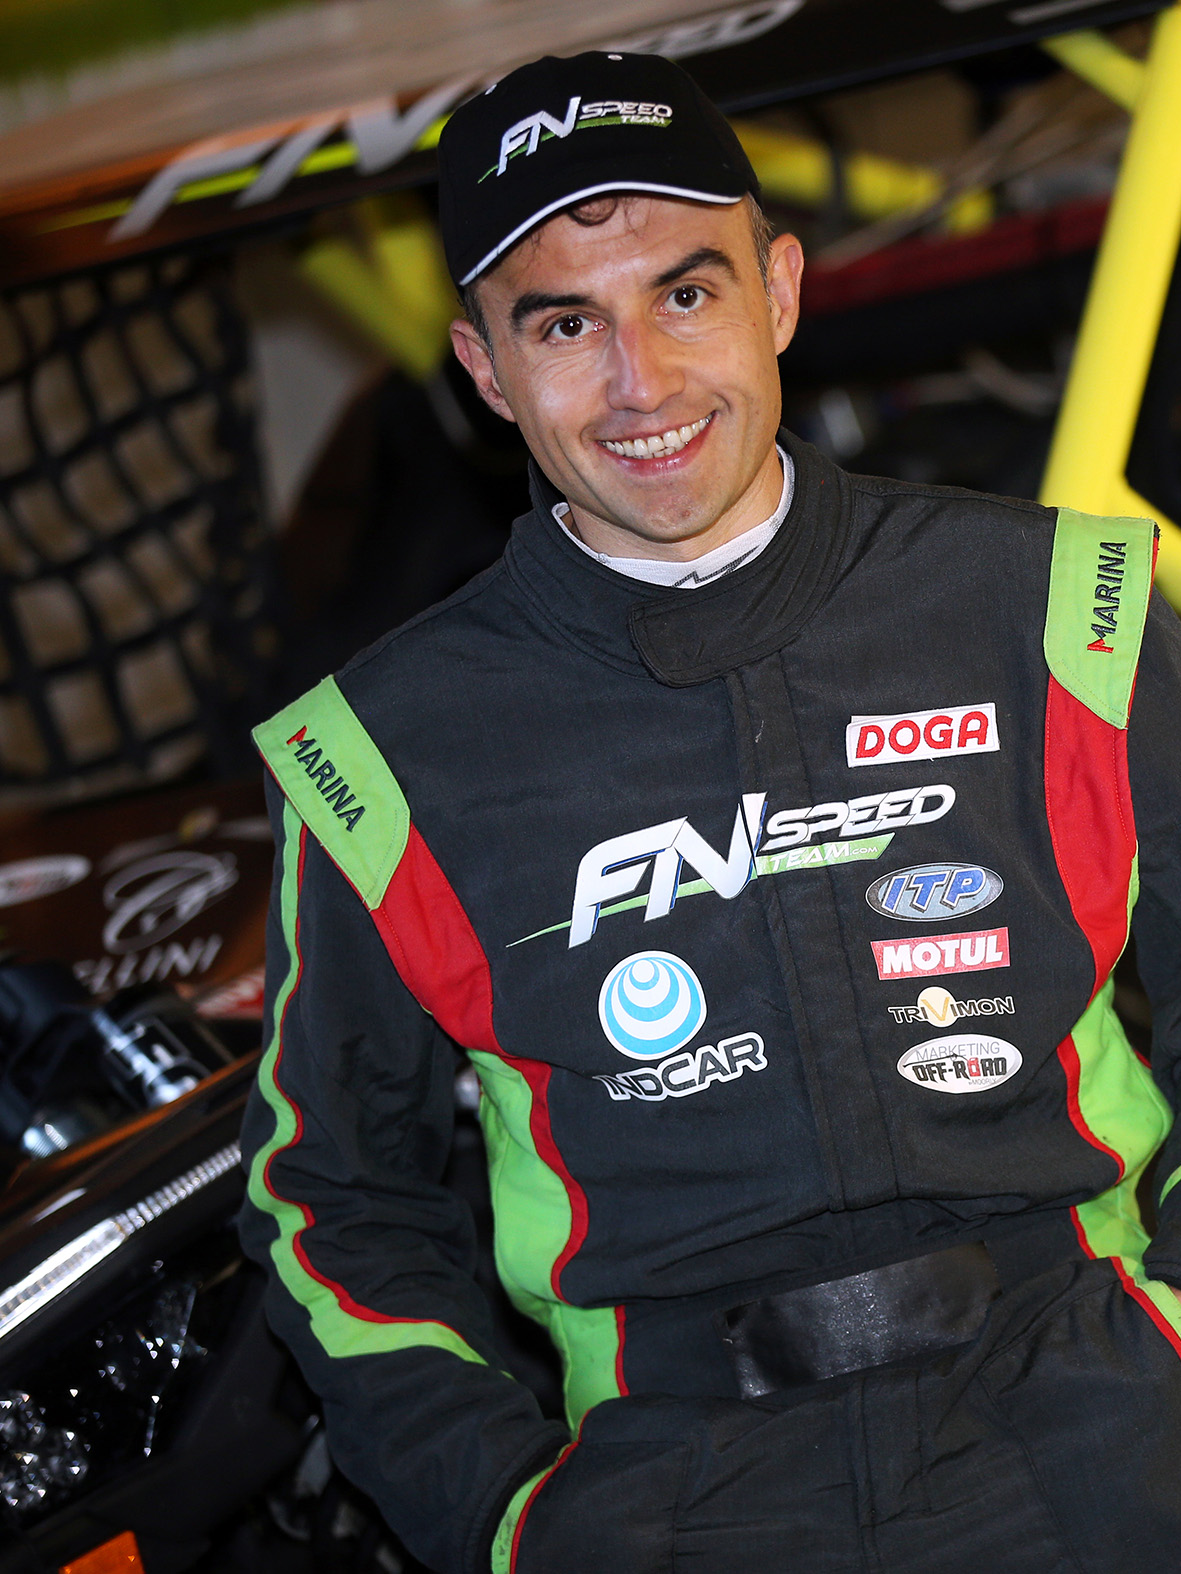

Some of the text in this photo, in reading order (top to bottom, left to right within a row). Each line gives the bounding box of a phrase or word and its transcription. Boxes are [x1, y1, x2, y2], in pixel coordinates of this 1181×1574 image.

[496, 96, 674, 177] FN SPEED
[620, 114, 666, 125] TEAM
[1087, 541, 1127, 653] MARINA
[856, 711, 989, 758] DOGA
[286, 725, 366, 832] MARINA
[568, 784, 956, 948] FN SPEED
[881, 867, 987, 913] ITP
[882, 935, 1003, 974] MOTUL
[888, 995, 1015, 1023] TRIVIMON
[594, 1036, 765, 1098] INDCAR
[911, 1056, 1007, 1083] OFF-ROAD
[915, 1042, 1000, 1062] MARKETING
